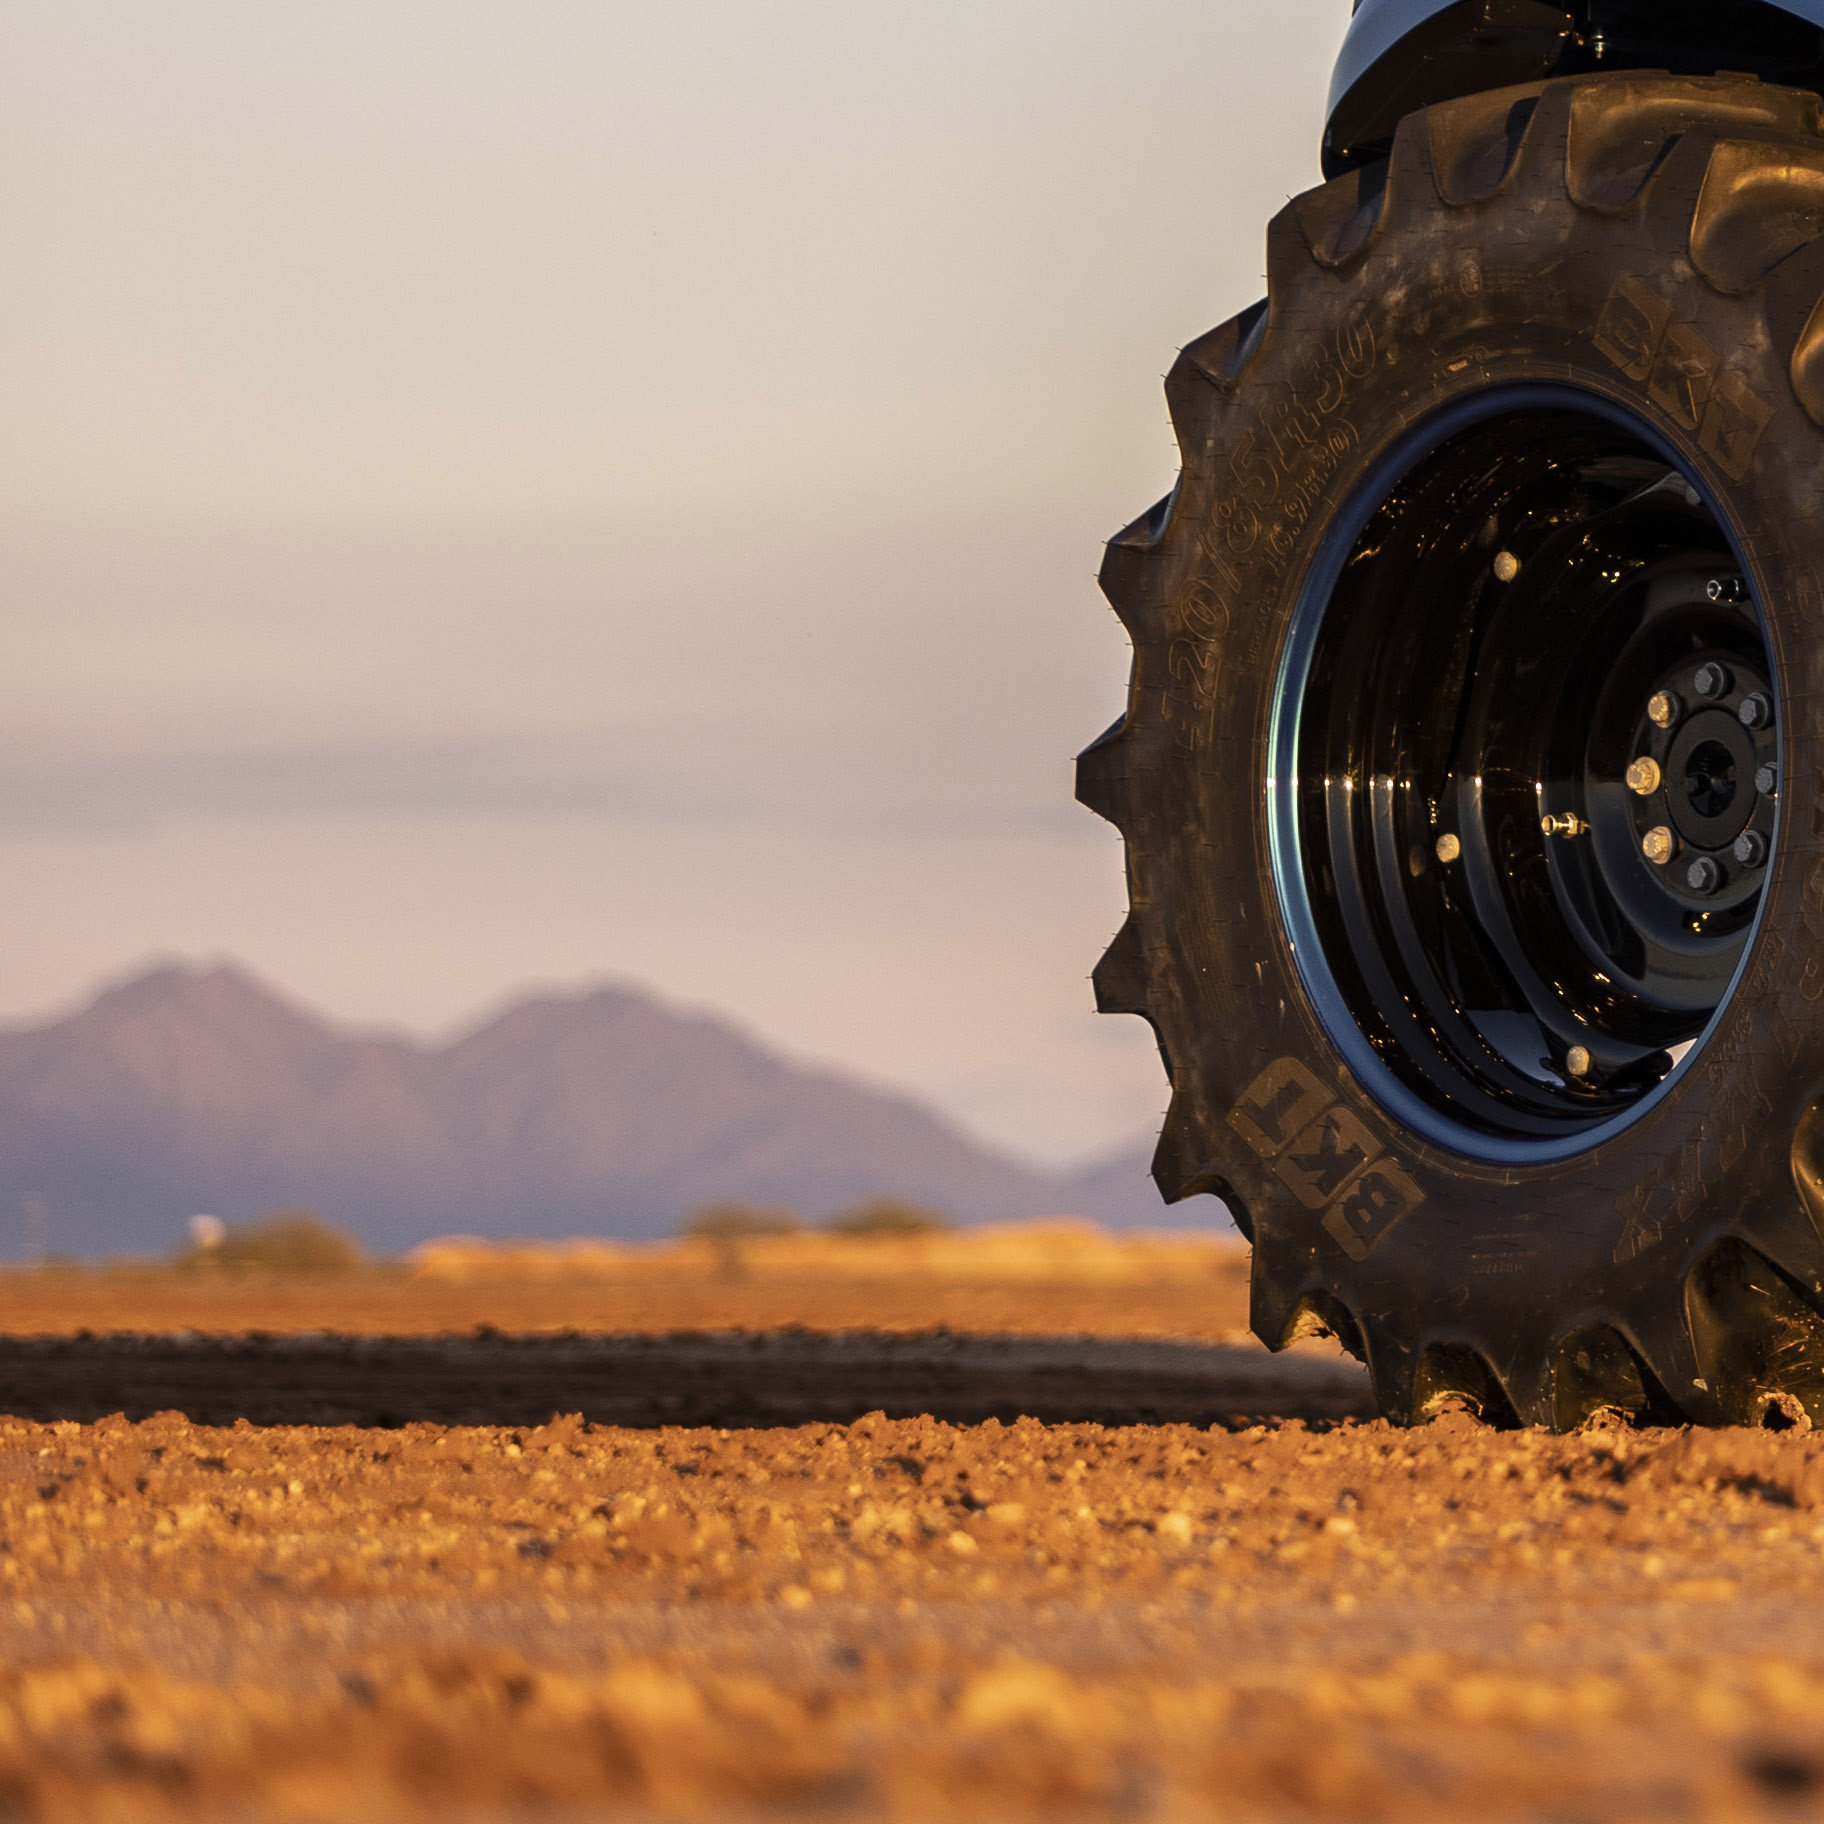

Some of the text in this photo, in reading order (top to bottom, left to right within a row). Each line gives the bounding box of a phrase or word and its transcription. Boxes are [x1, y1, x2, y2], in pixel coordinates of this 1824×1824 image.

[1594, 278, 1774, 479] BKT
[1161, 309, 1377, 750] 420/85R30
[1230, 1062, 1421, 1259] BKT
